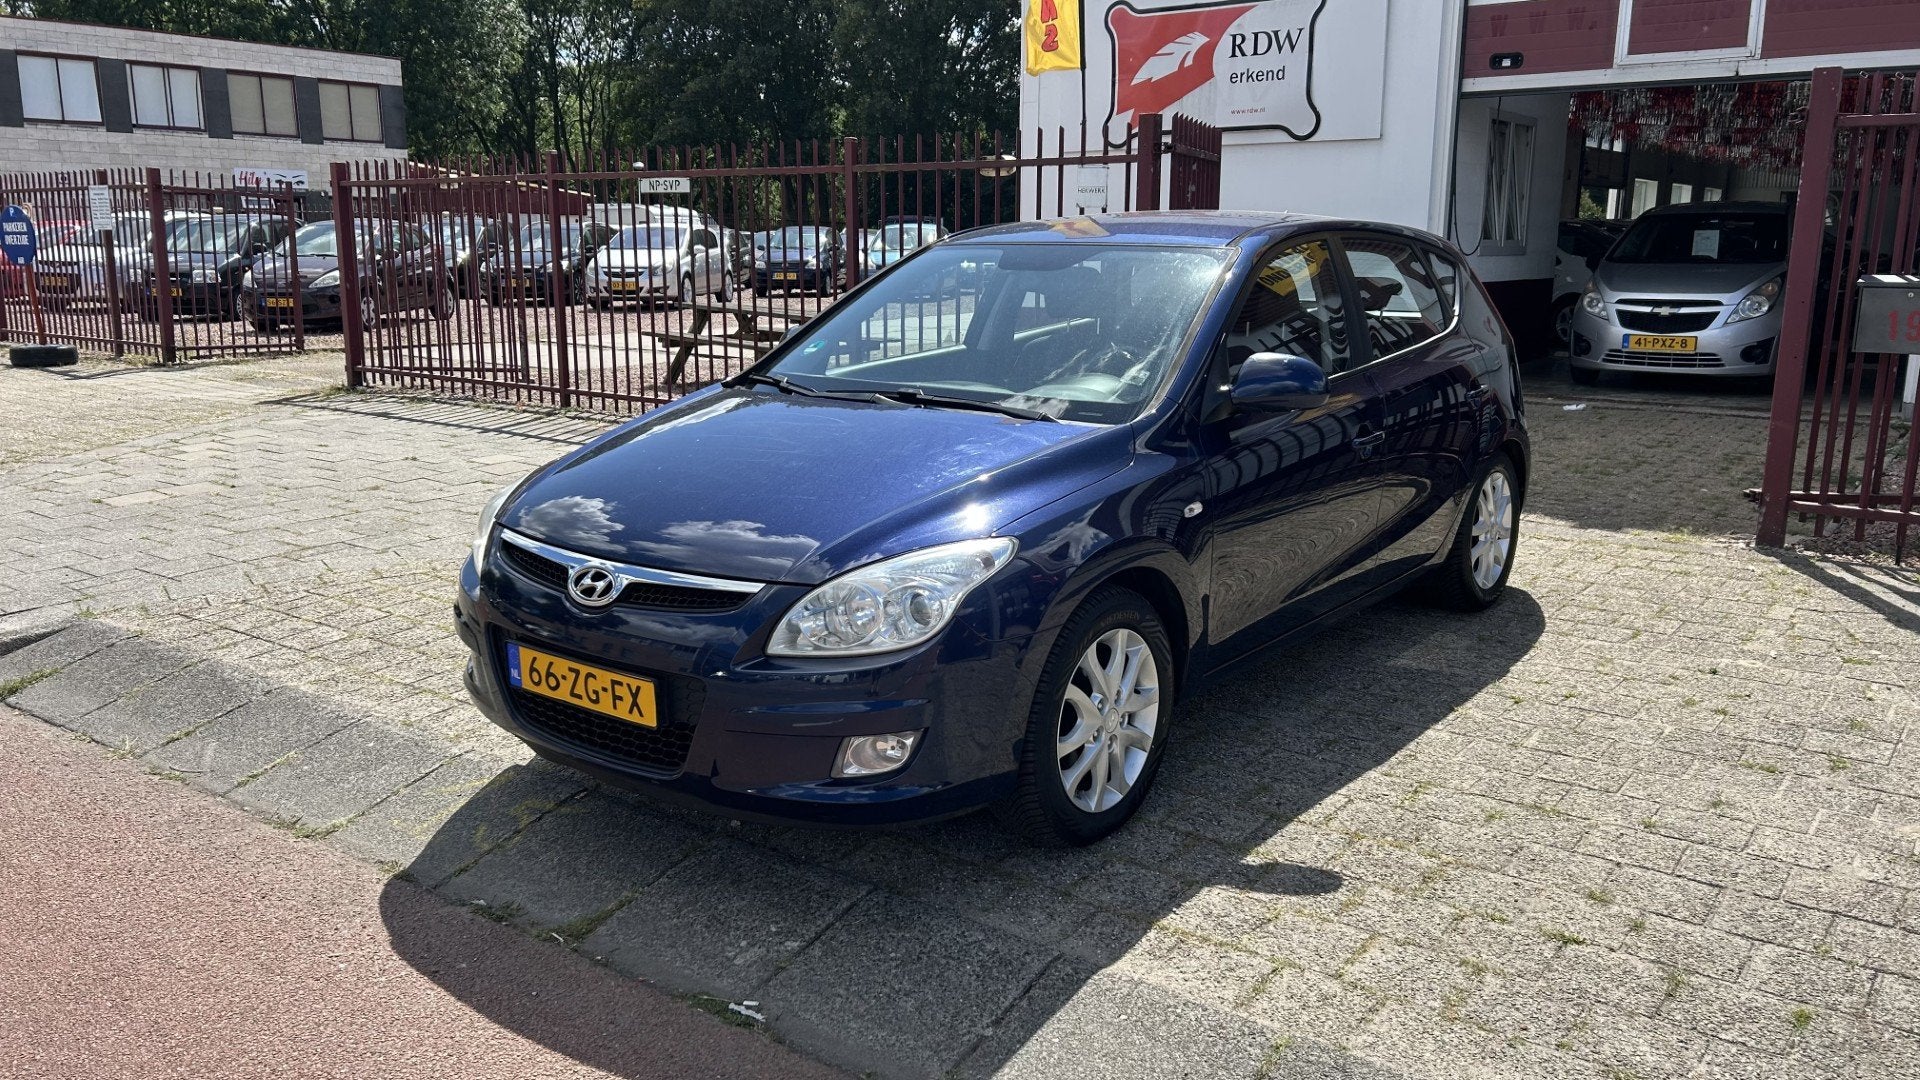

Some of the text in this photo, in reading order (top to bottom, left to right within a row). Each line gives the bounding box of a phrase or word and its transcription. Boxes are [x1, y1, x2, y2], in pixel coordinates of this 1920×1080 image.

[1228, 27, 1305, 58] RDW
[1229, 65, 1286, 84] erkend
[1230, 106, 1266, 115] www.rdw.nl
[1634, 337, 1688, 349] 41-PXZ-8
[511, 668, 521, 680] NL
[528, 656, 645, 718] 66-ZG-FX
